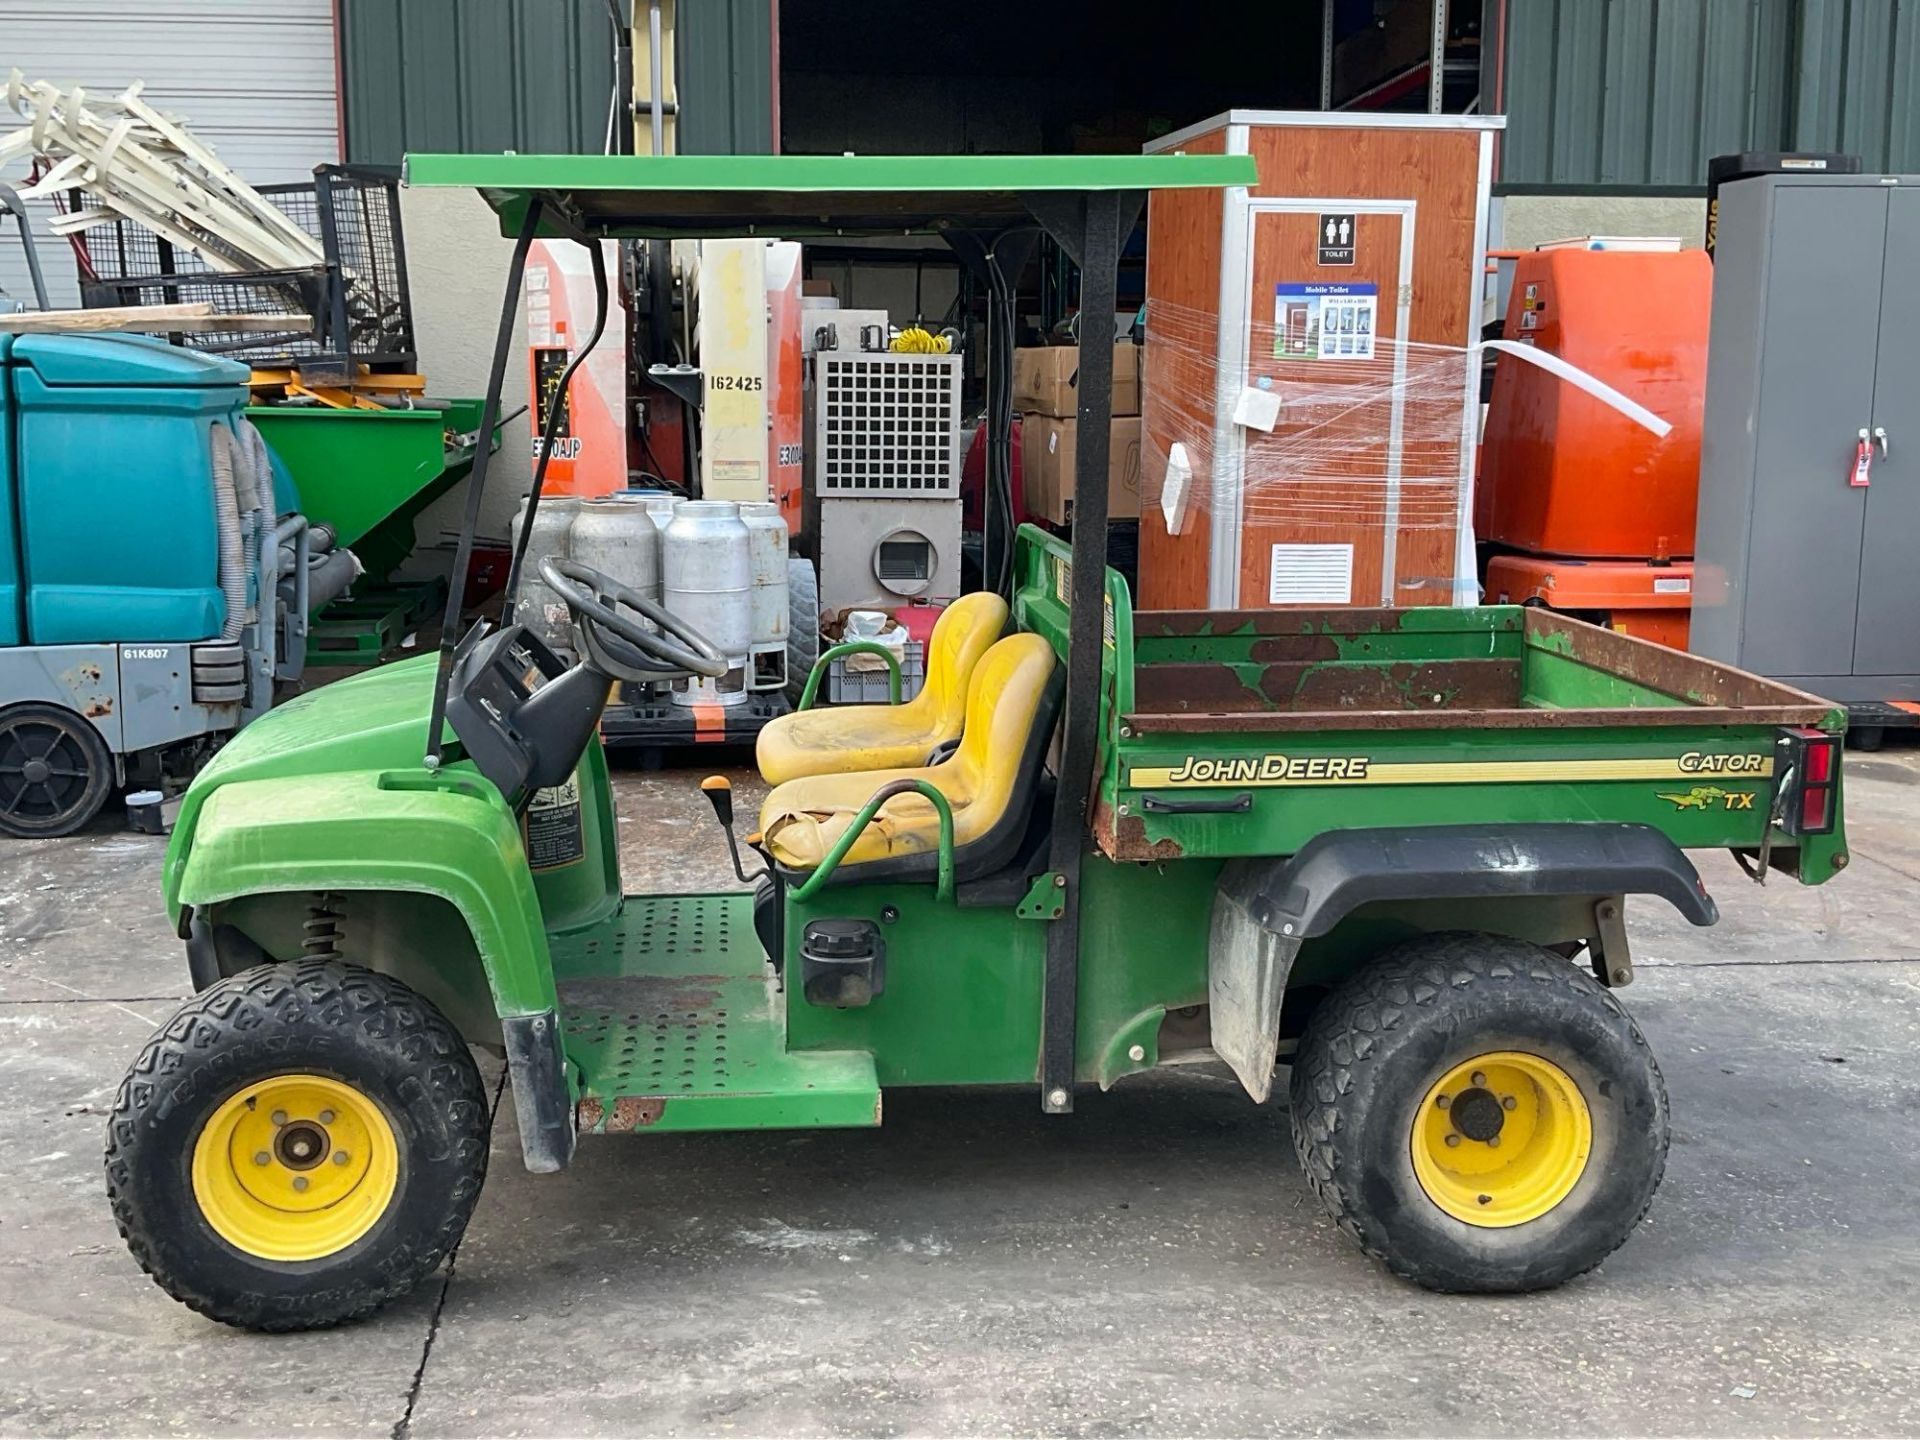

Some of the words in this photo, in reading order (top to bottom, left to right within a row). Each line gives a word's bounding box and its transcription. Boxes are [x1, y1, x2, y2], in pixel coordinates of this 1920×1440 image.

[1324, 250, 1349, 258] TOILET
[1305, 286, 1328, 294] Mobile
[1328, 286, 1349, 294] Toilet
[710, 375, 762, 392] 162425
[123, 648, 169, 660] 61K807
[1170, 755, 1259, 781] JOHN
[1259, 753, 1370, 780] DEERE
[1678, 751, 1762, 773] GATOR
[1723, 792, 1757, 810] TX
